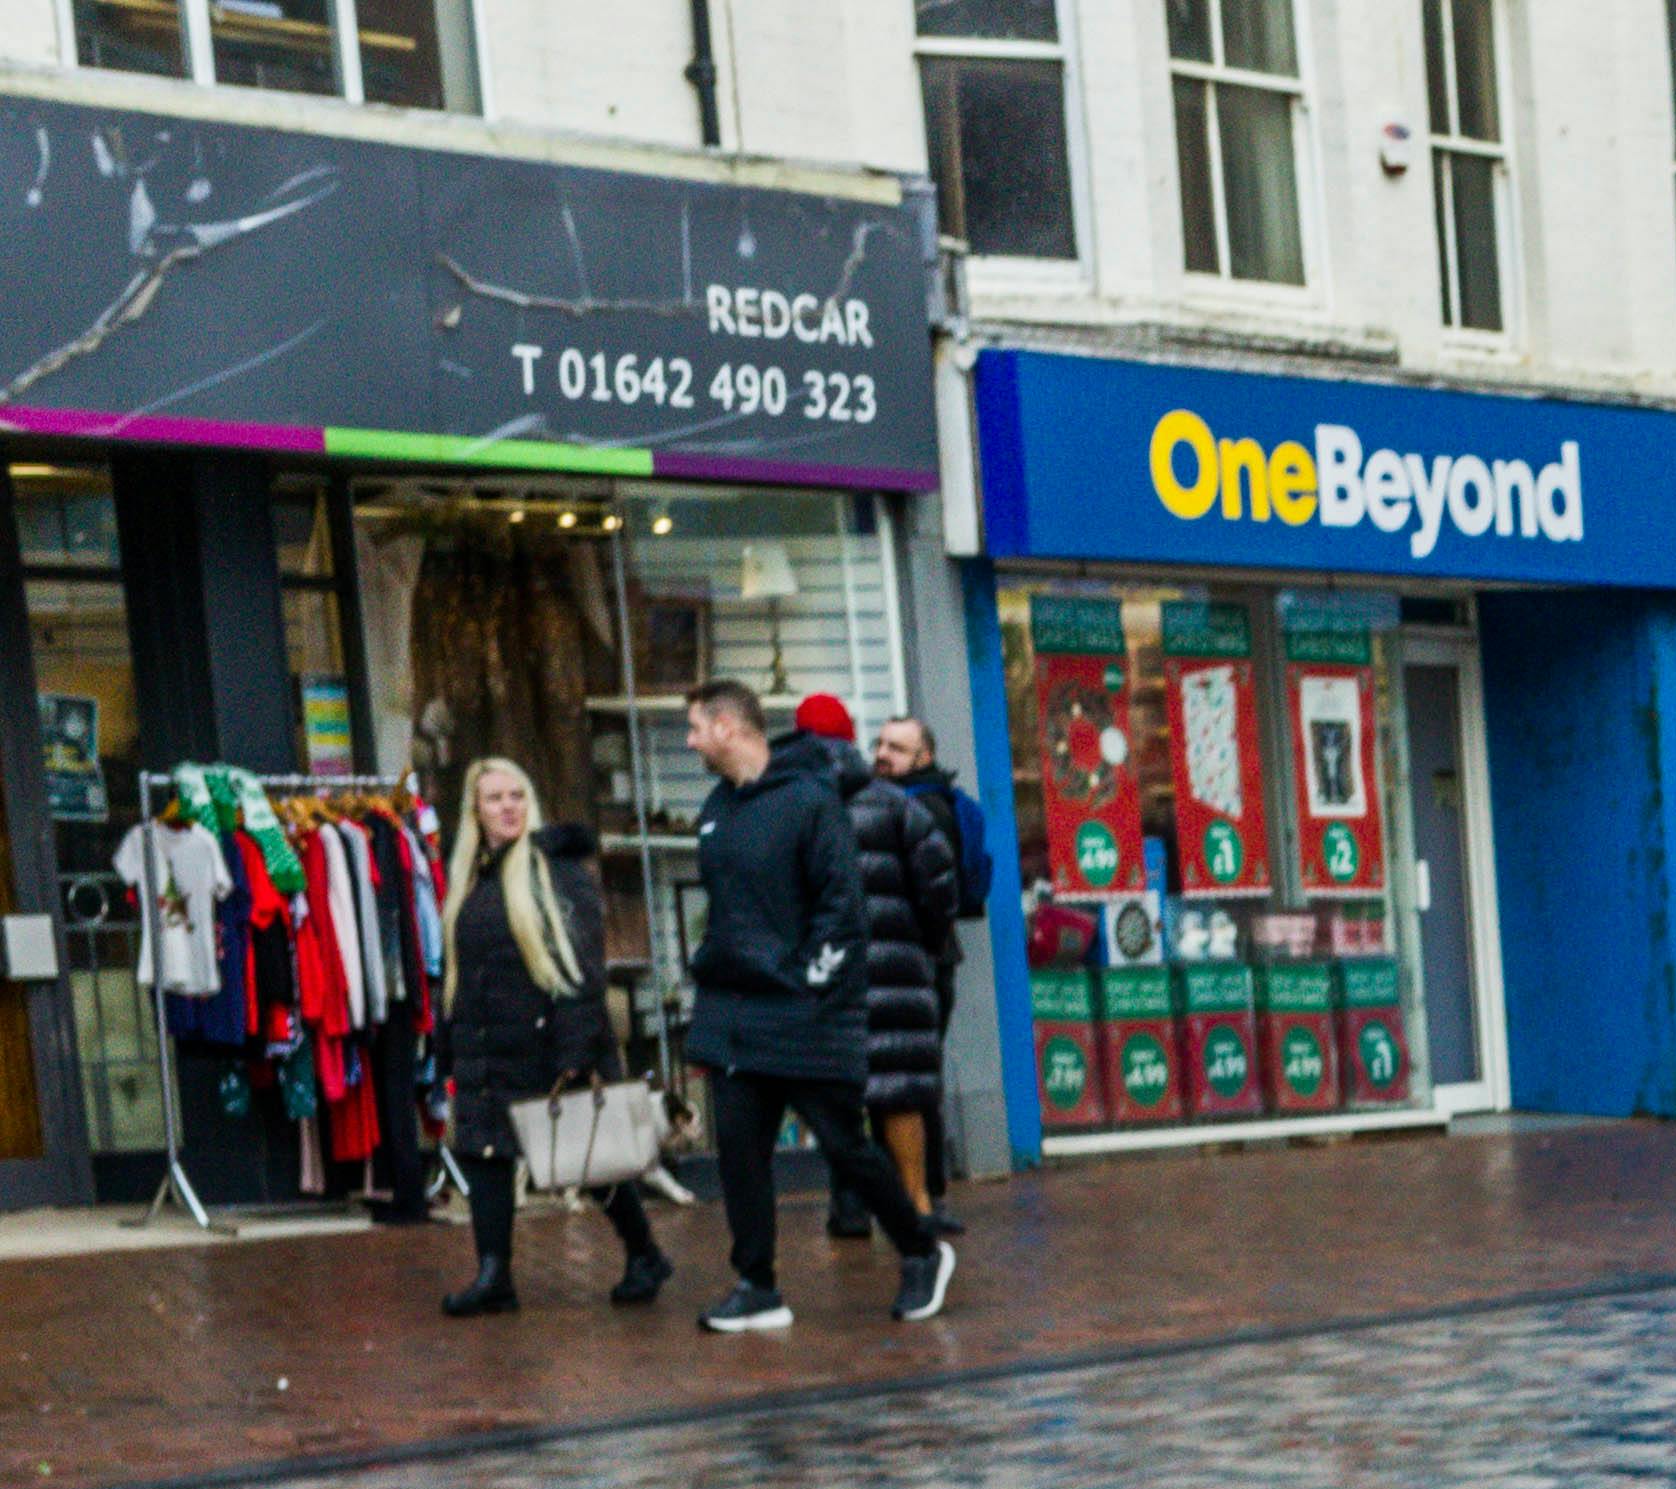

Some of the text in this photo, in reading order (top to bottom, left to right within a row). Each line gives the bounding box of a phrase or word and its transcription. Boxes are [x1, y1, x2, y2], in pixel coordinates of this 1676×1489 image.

[707, 283, 874, 349] REDCAR
[511, 344, 877, 424] T 01642 490 323
[1150, 409, 1583, 558] OneBeyond
